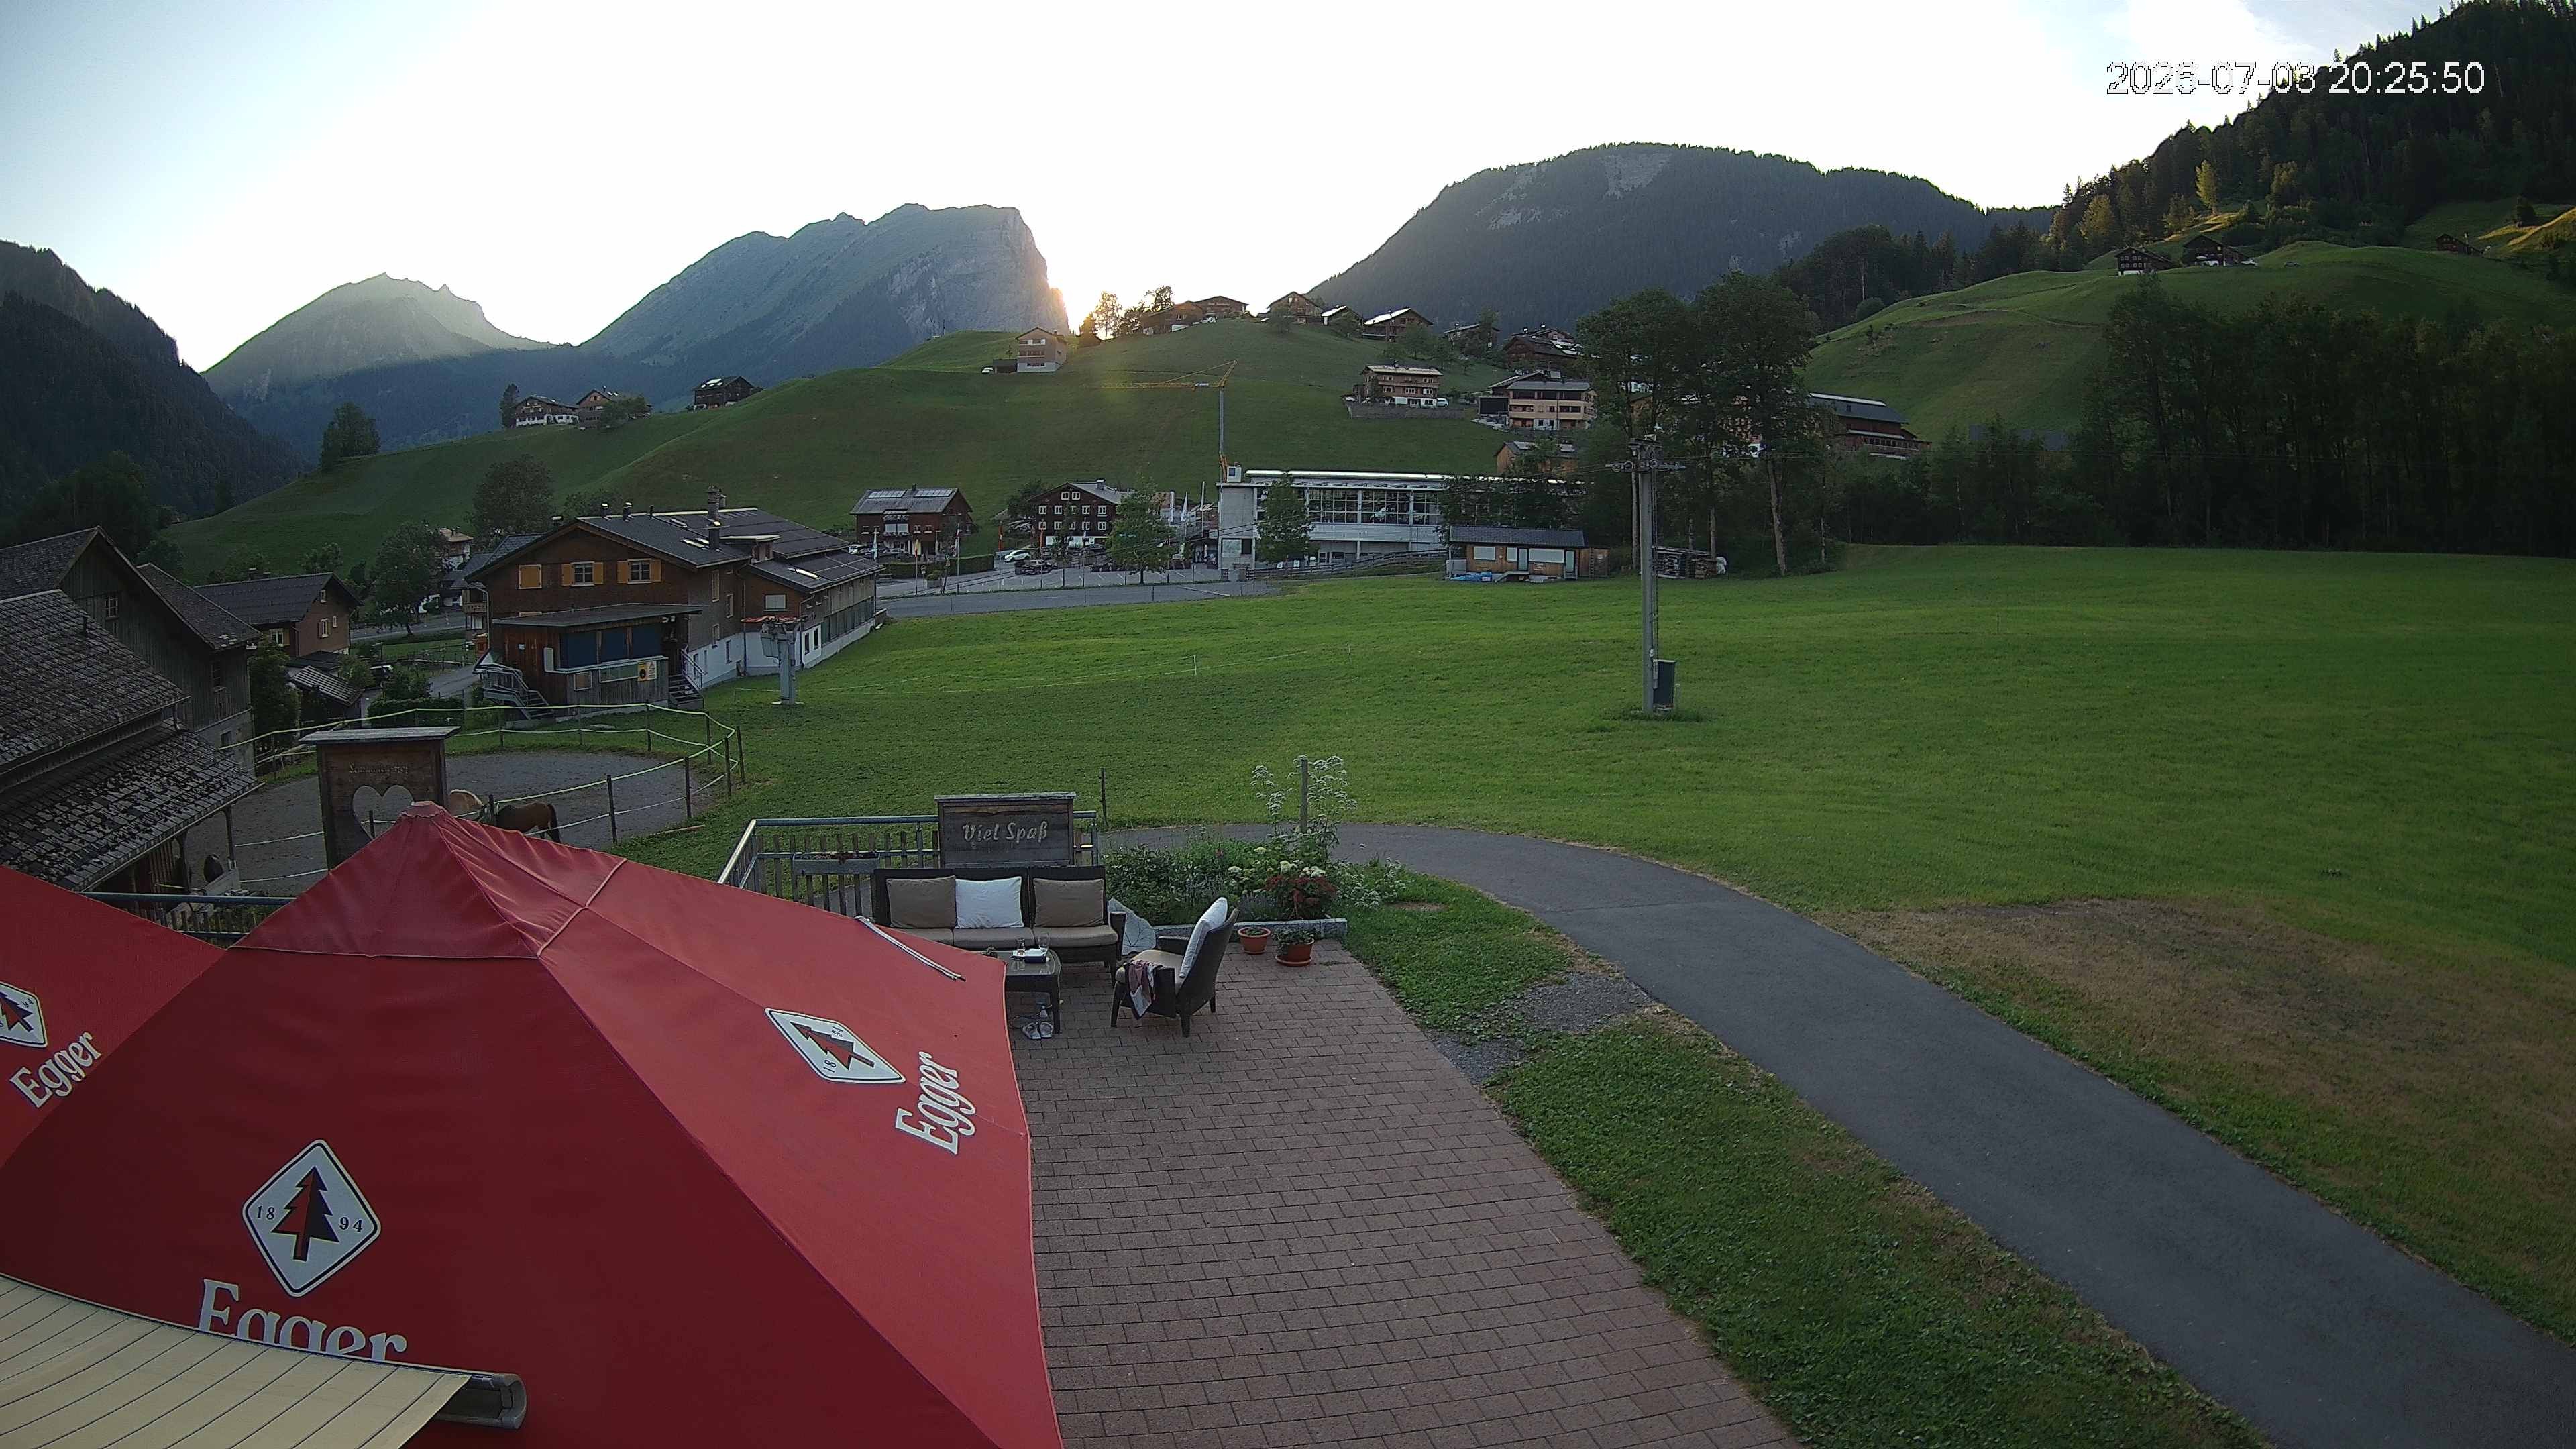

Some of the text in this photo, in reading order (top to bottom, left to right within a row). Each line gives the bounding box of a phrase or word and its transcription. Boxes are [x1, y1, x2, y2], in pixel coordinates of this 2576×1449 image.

[963, 820, 1048, 844] Viel Spaß
[9, 1032, 102, 1108] Egger
[895, 1051, 976, 1155] Egger
[256, 1205, 364, 1233] 18 94
